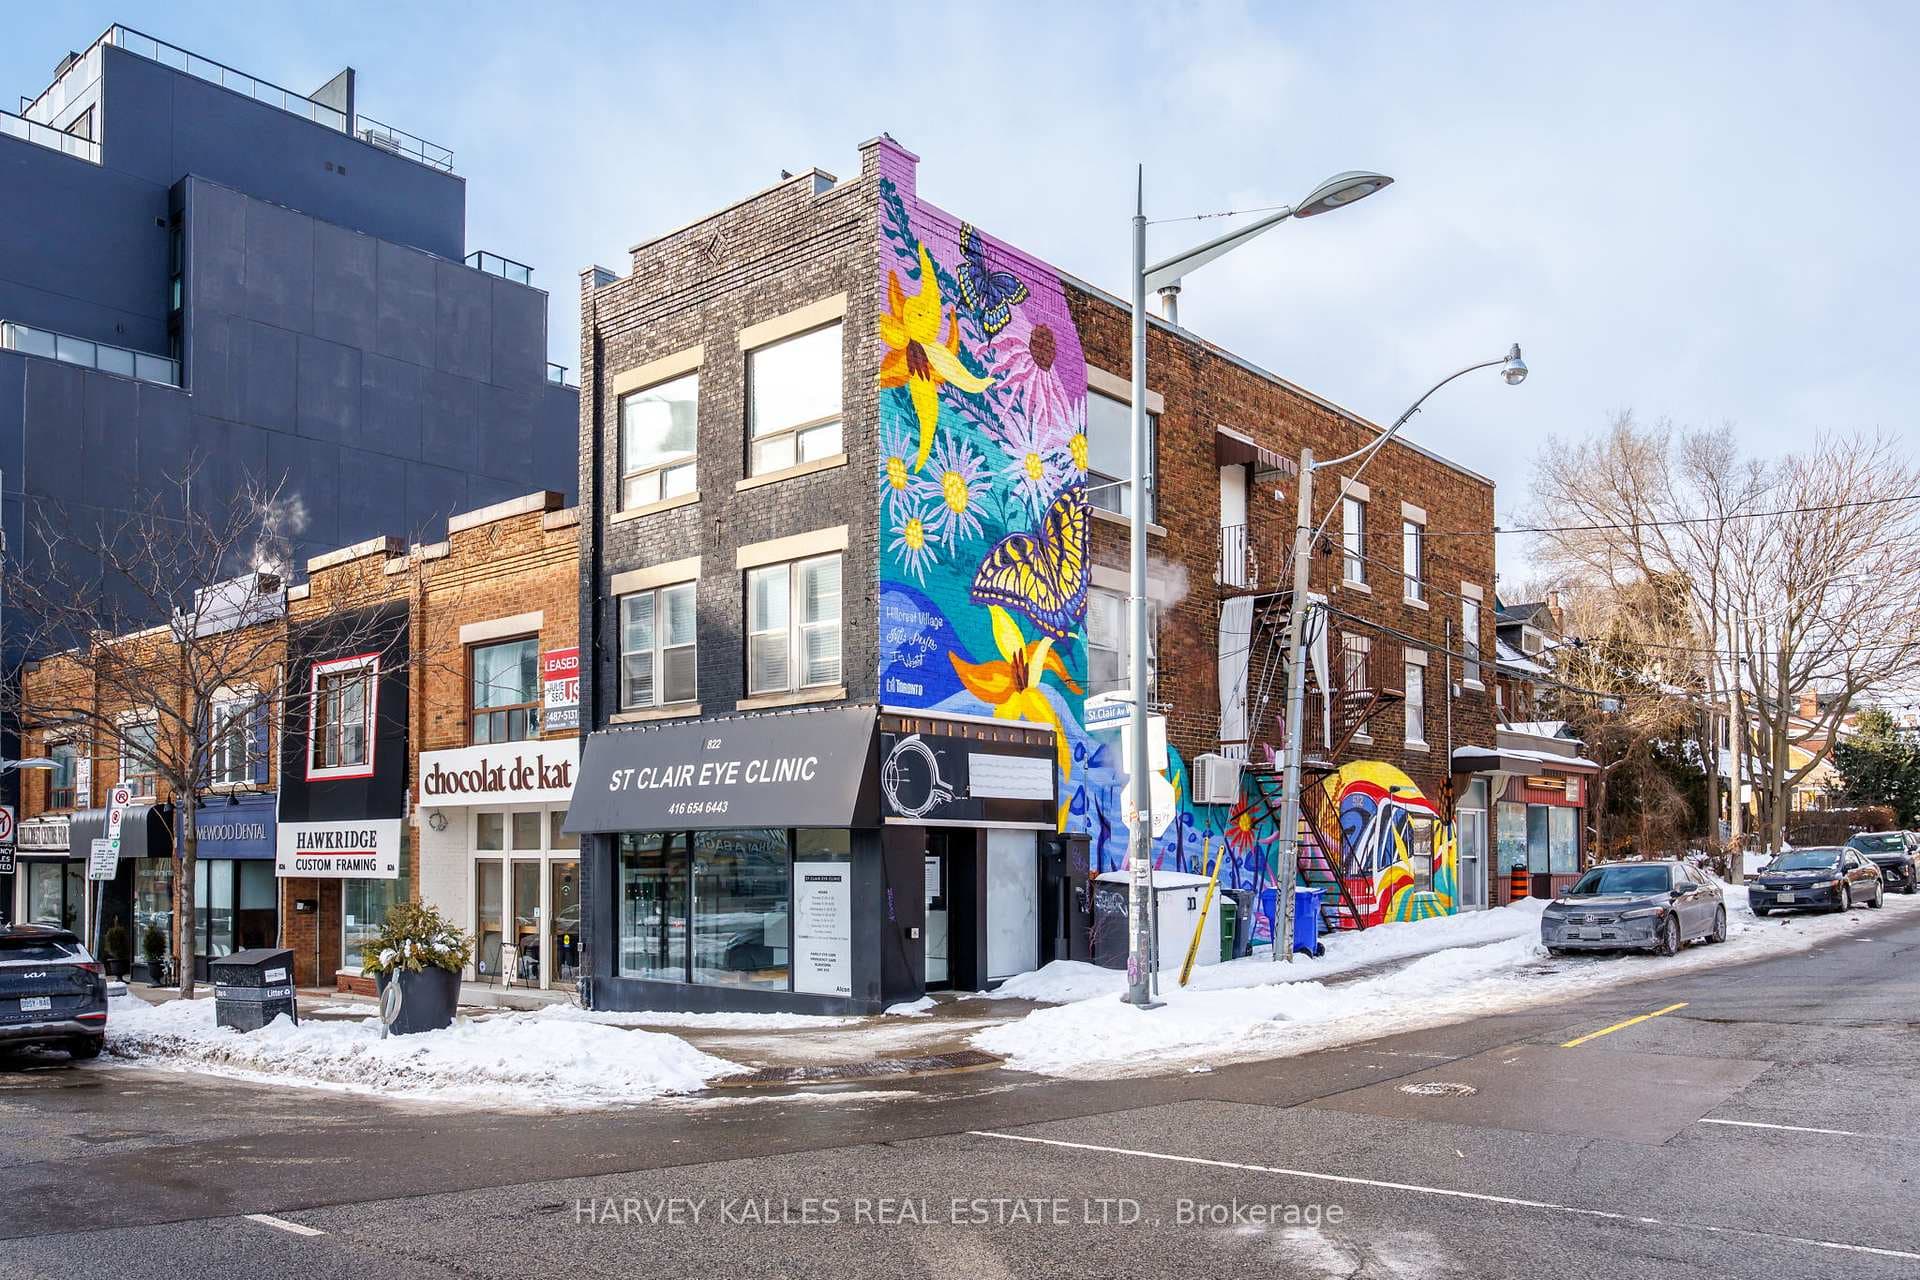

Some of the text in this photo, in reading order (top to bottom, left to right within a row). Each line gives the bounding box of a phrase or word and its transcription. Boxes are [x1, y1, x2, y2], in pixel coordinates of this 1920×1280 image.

[919, 612, 943, 630] Village
[545, 656, 579, 672] LEASED
[1098, 706, 1116, 720] Clair
[1117, 708, 1125, 716] Av
[707, 739, 721, 750] 822
[424, 754, 572, 795] chocolat de kat
[609, 756, 818, 792] ST CLAIR EYE CLINIC
[668, 801, 729, 815] 416 654 6443
[235, 822, 267, 840] DENTAL
[296, 830, 377, 849] HAWKRIDGE
[295, 858, 331, 871] CUSTOM
[336, 858, 377, 871] FRAMING
[267, 987, 284, 998] Litter
